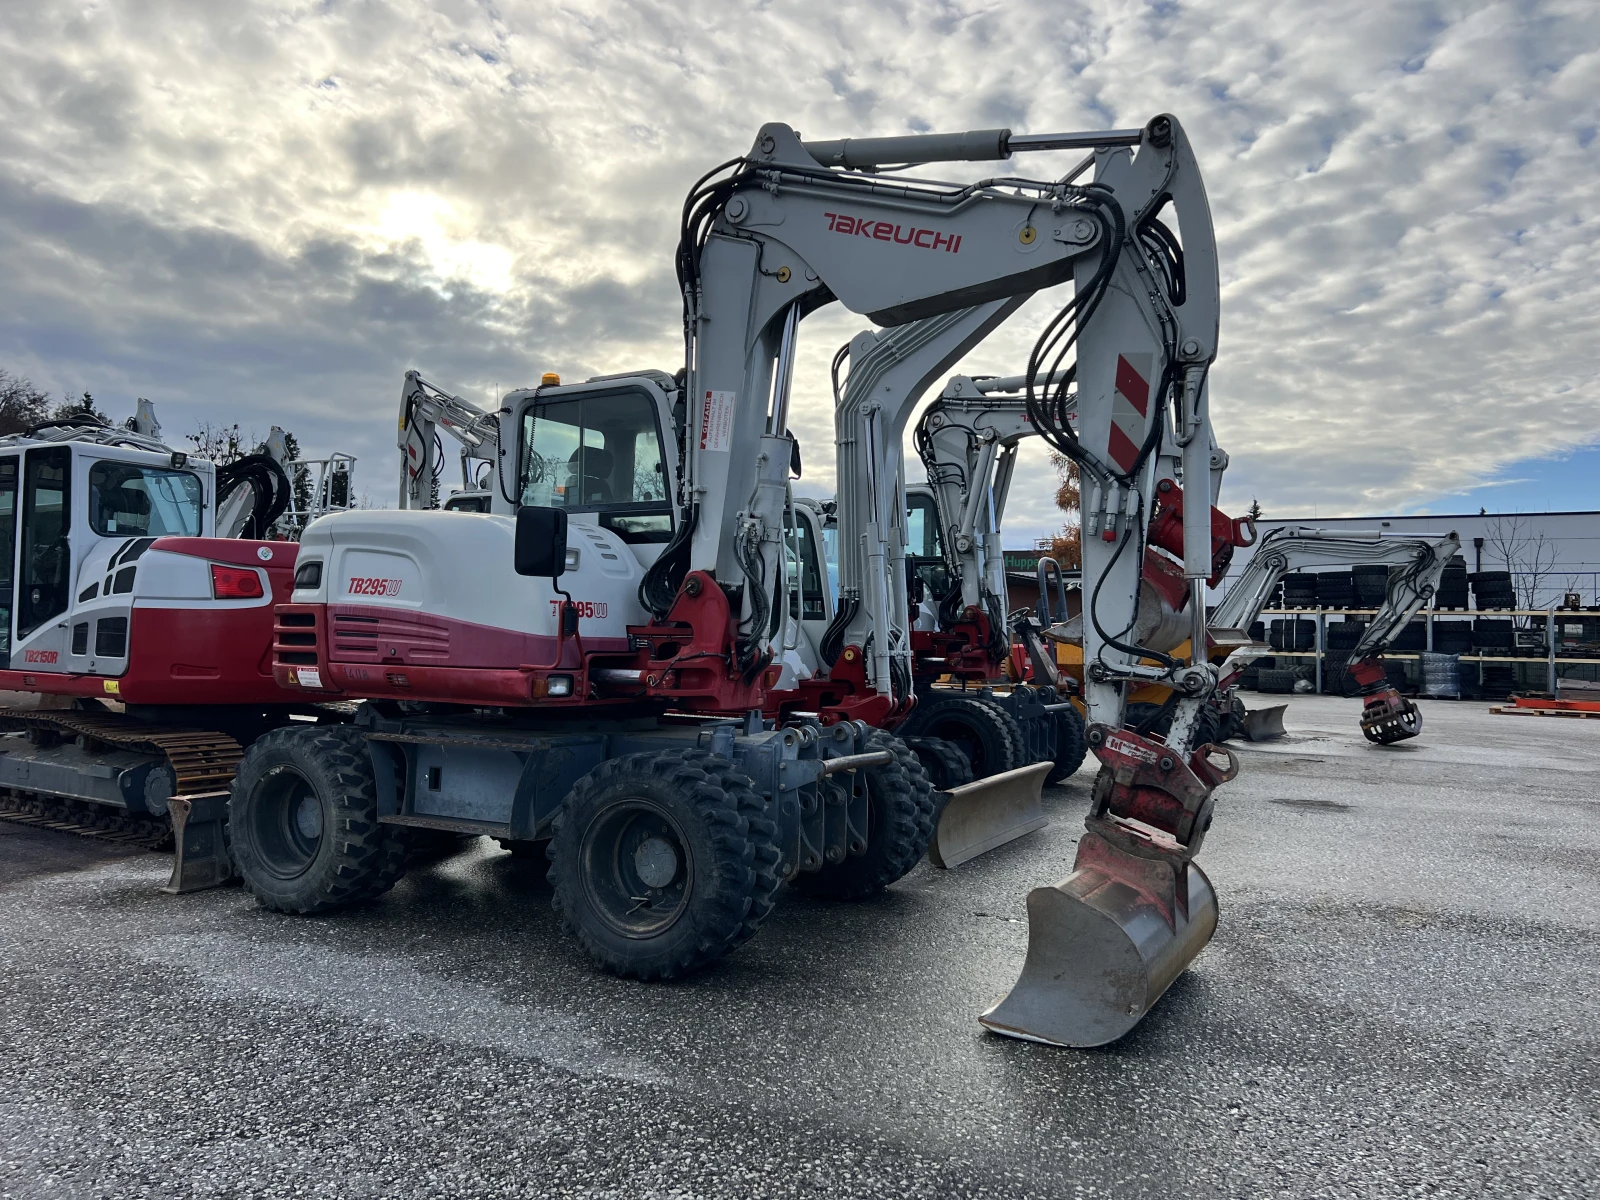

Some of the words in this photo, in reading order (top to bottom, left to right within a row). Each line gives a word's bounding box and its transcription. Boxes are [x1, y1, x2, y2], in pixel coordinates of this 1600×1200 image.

[702, 397, 712, 434] GEFAHR
[348, 577, 402, 596] TB295W
[24, 650, 59, 664] TB2150R
